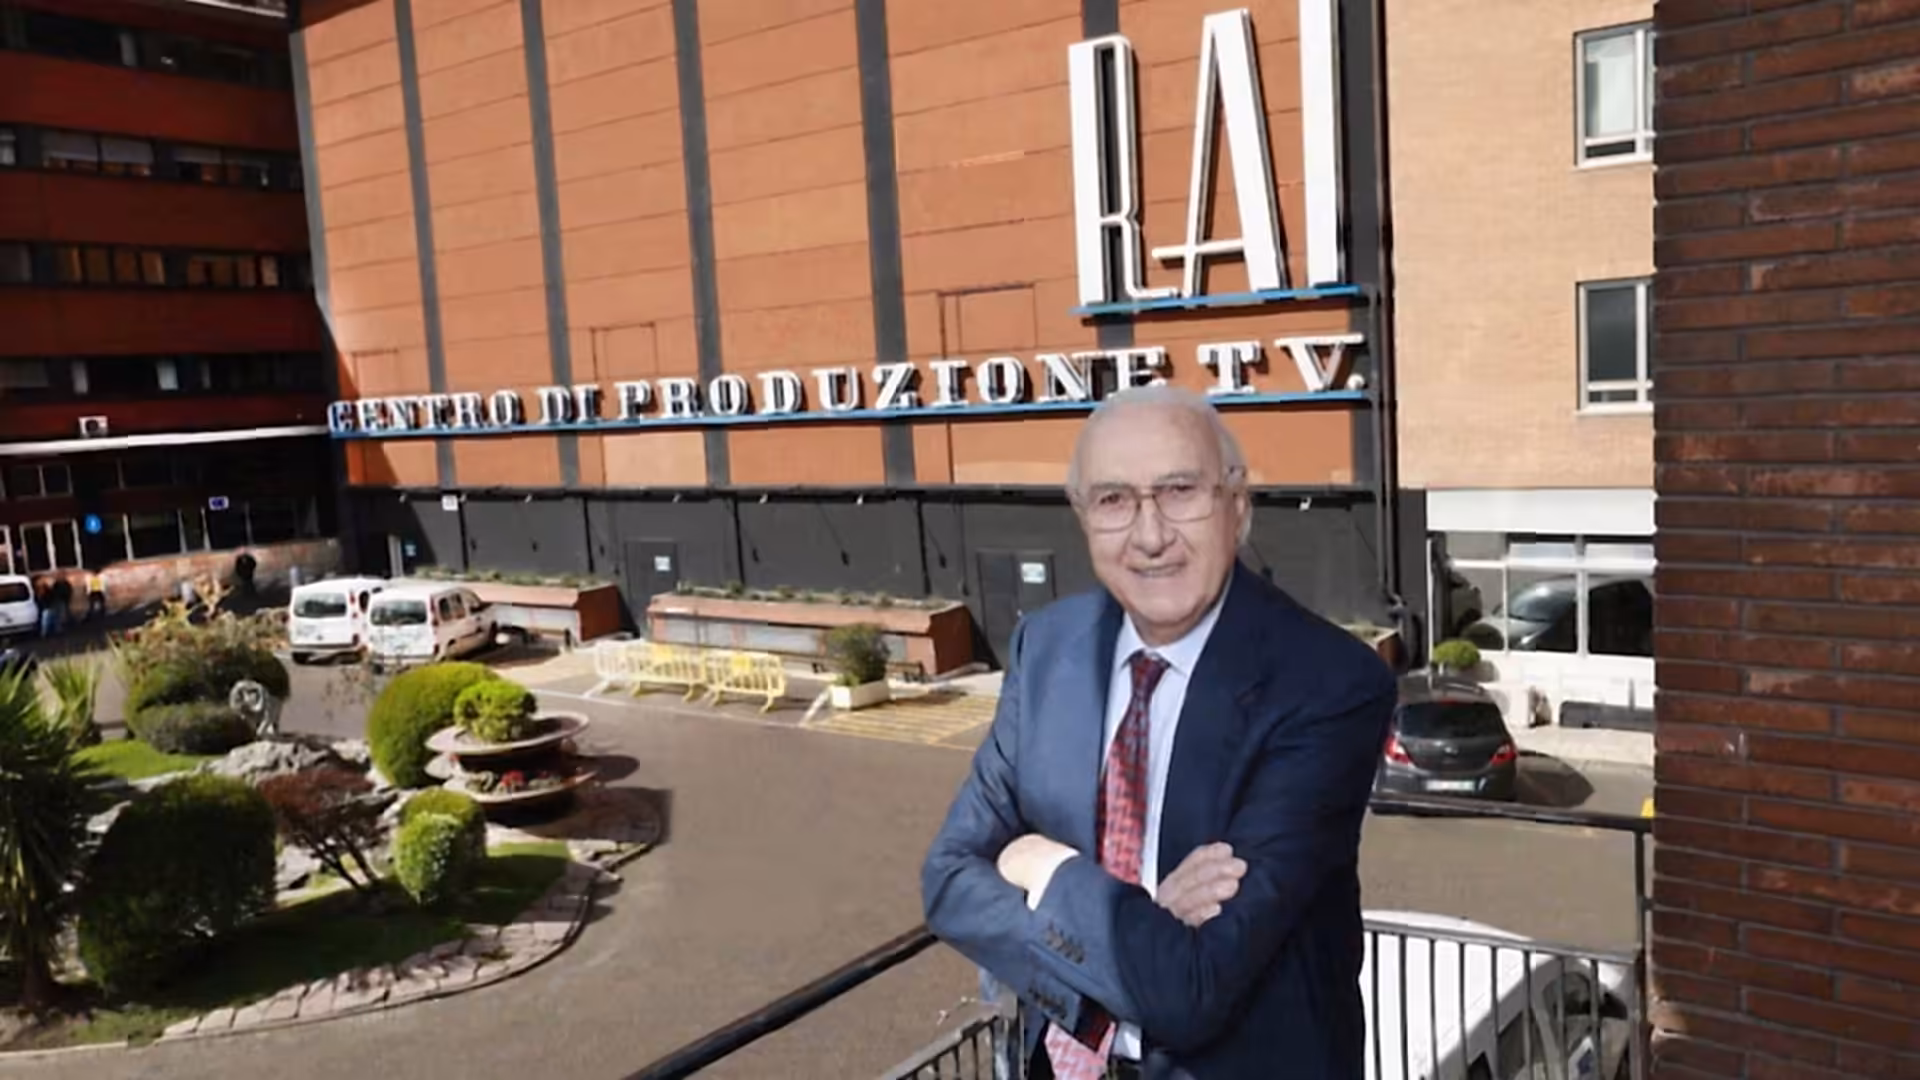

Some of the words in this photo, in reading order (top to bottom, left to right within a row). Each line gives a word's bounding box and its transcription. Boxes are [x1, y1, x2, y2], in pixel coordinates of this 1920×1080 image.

[1068, 0, 1343, 306] RAI
[328, 391, 524, 432] CENTRO
[536, 385, 601, 422] DI
[615, 346, 1168, 420] PRODUZIONE
